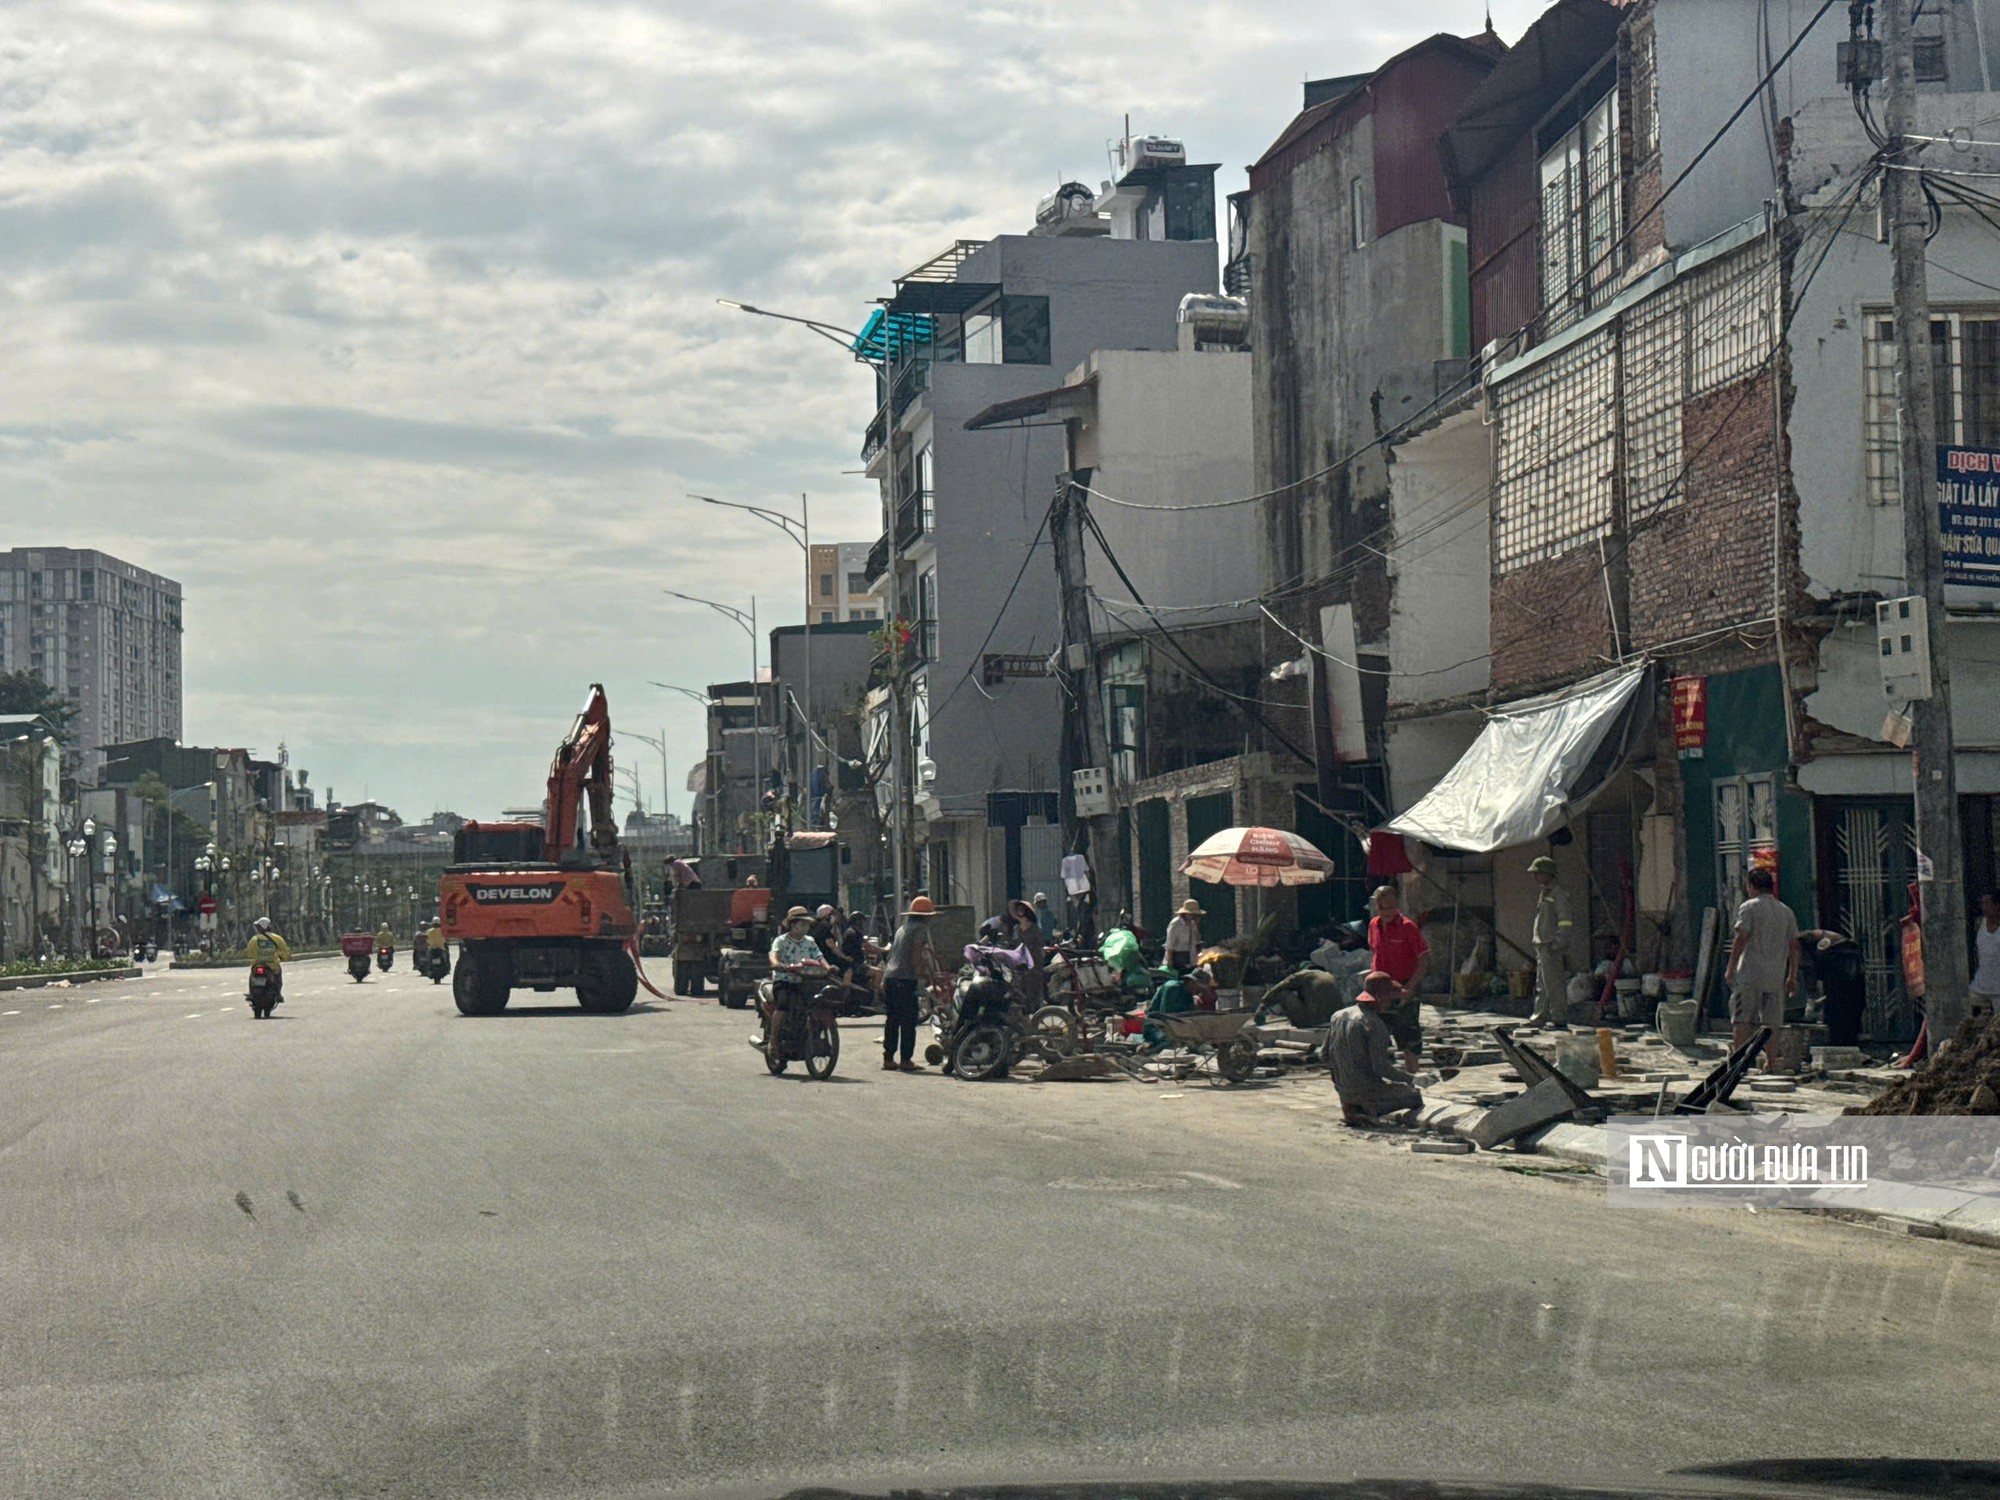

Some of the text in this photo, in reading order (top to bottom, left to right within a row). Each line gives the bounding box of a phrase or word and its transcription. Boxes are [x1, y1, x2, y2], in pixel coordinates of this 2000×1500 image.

[1947, 451, 1990, 473] DỊCH
[1961, 479, 1976, 506] LÀ
[1978, 478, 2000, 508] LẤY
[476, 888, 553, 900] DEVELON
